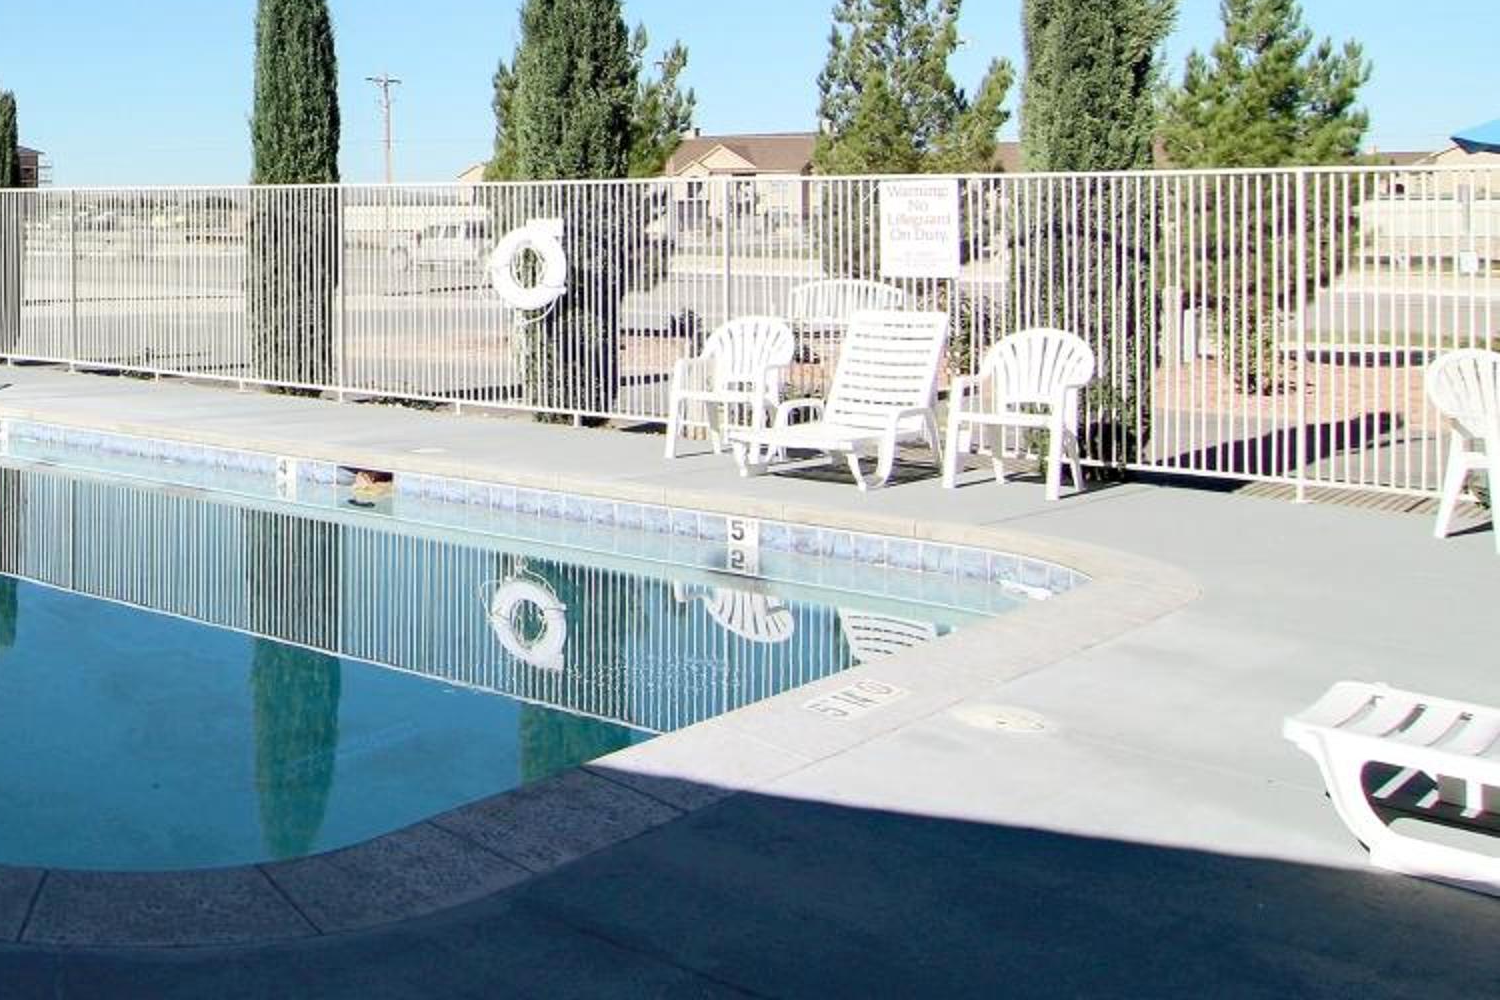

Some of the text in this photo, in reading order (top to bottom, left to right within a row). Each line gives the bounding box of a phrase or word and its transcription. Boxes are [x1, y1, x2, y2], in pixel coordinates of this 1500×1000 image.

[908, 199, 929, 213] No
[887, 213, 951, 227] Lifeguard
[890, 228, 911, 241] On
[731, 519, 745, 541] 5
